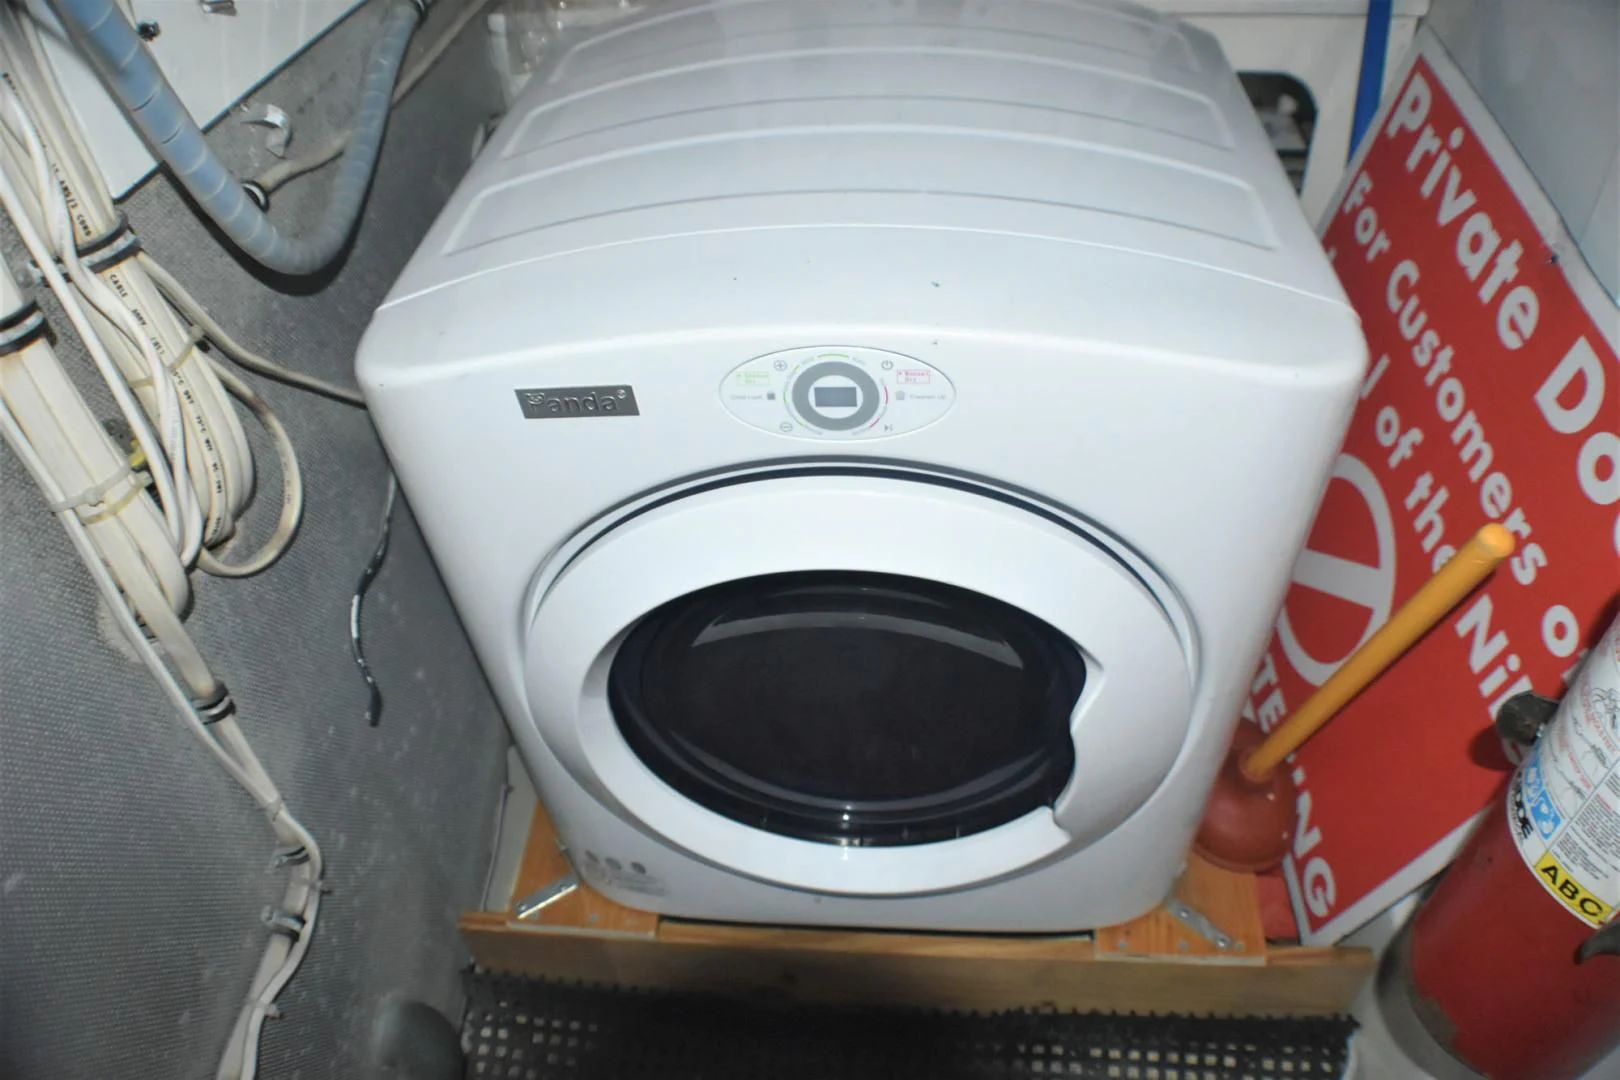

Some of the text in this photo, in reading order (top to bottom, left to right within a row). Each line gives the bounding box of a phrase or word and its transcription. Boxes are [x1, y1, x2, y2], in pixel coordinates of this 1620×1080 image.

[1341, 169, 1392, 263] For
[1385, 258, 1548, 586] Customers
[1375, 404, 1424, 469] of
[1387, 69, 1620, 565] Private Do
[1540, 864, 1604, 917] ABC
